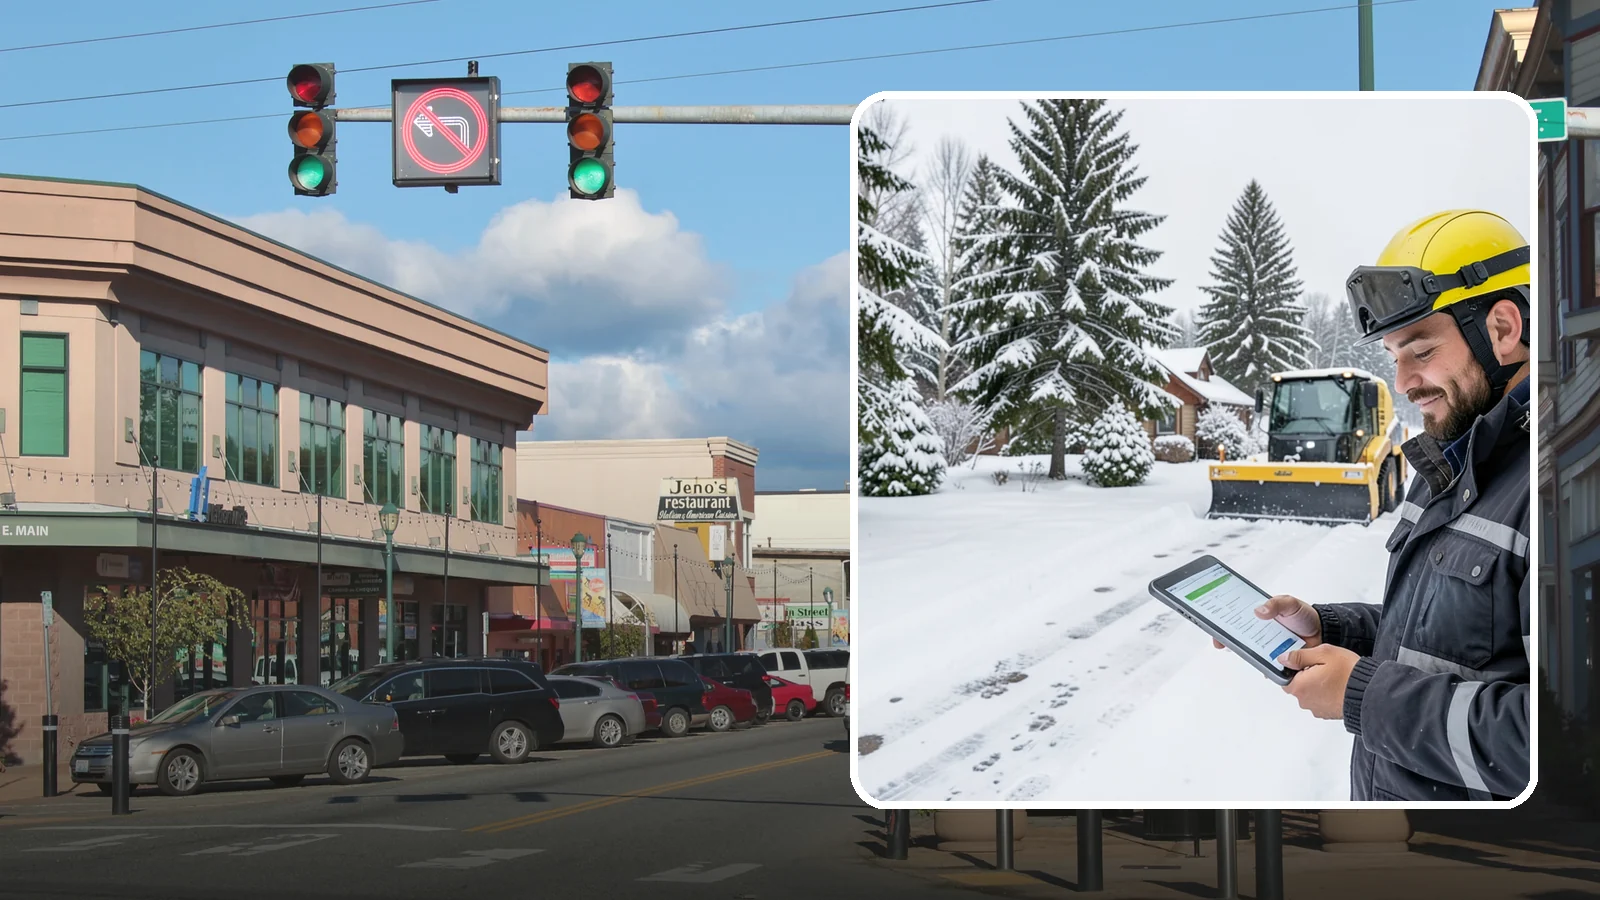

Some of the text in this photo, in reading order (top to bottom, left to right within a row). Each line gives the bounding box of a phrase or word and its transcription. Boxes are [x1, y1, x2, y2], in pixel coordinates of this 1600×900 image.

[670, 480, 727, 494] Jeno's
[665, 497, 731, 509] restaurant
[659, 510, 681, 519] Italian
[686, 509, 714, 519] American
[714, 509, 738, 519] Cuisine
[2, 525, 49, 536] E. MAIN
[797, 607, 829, 618] Street
